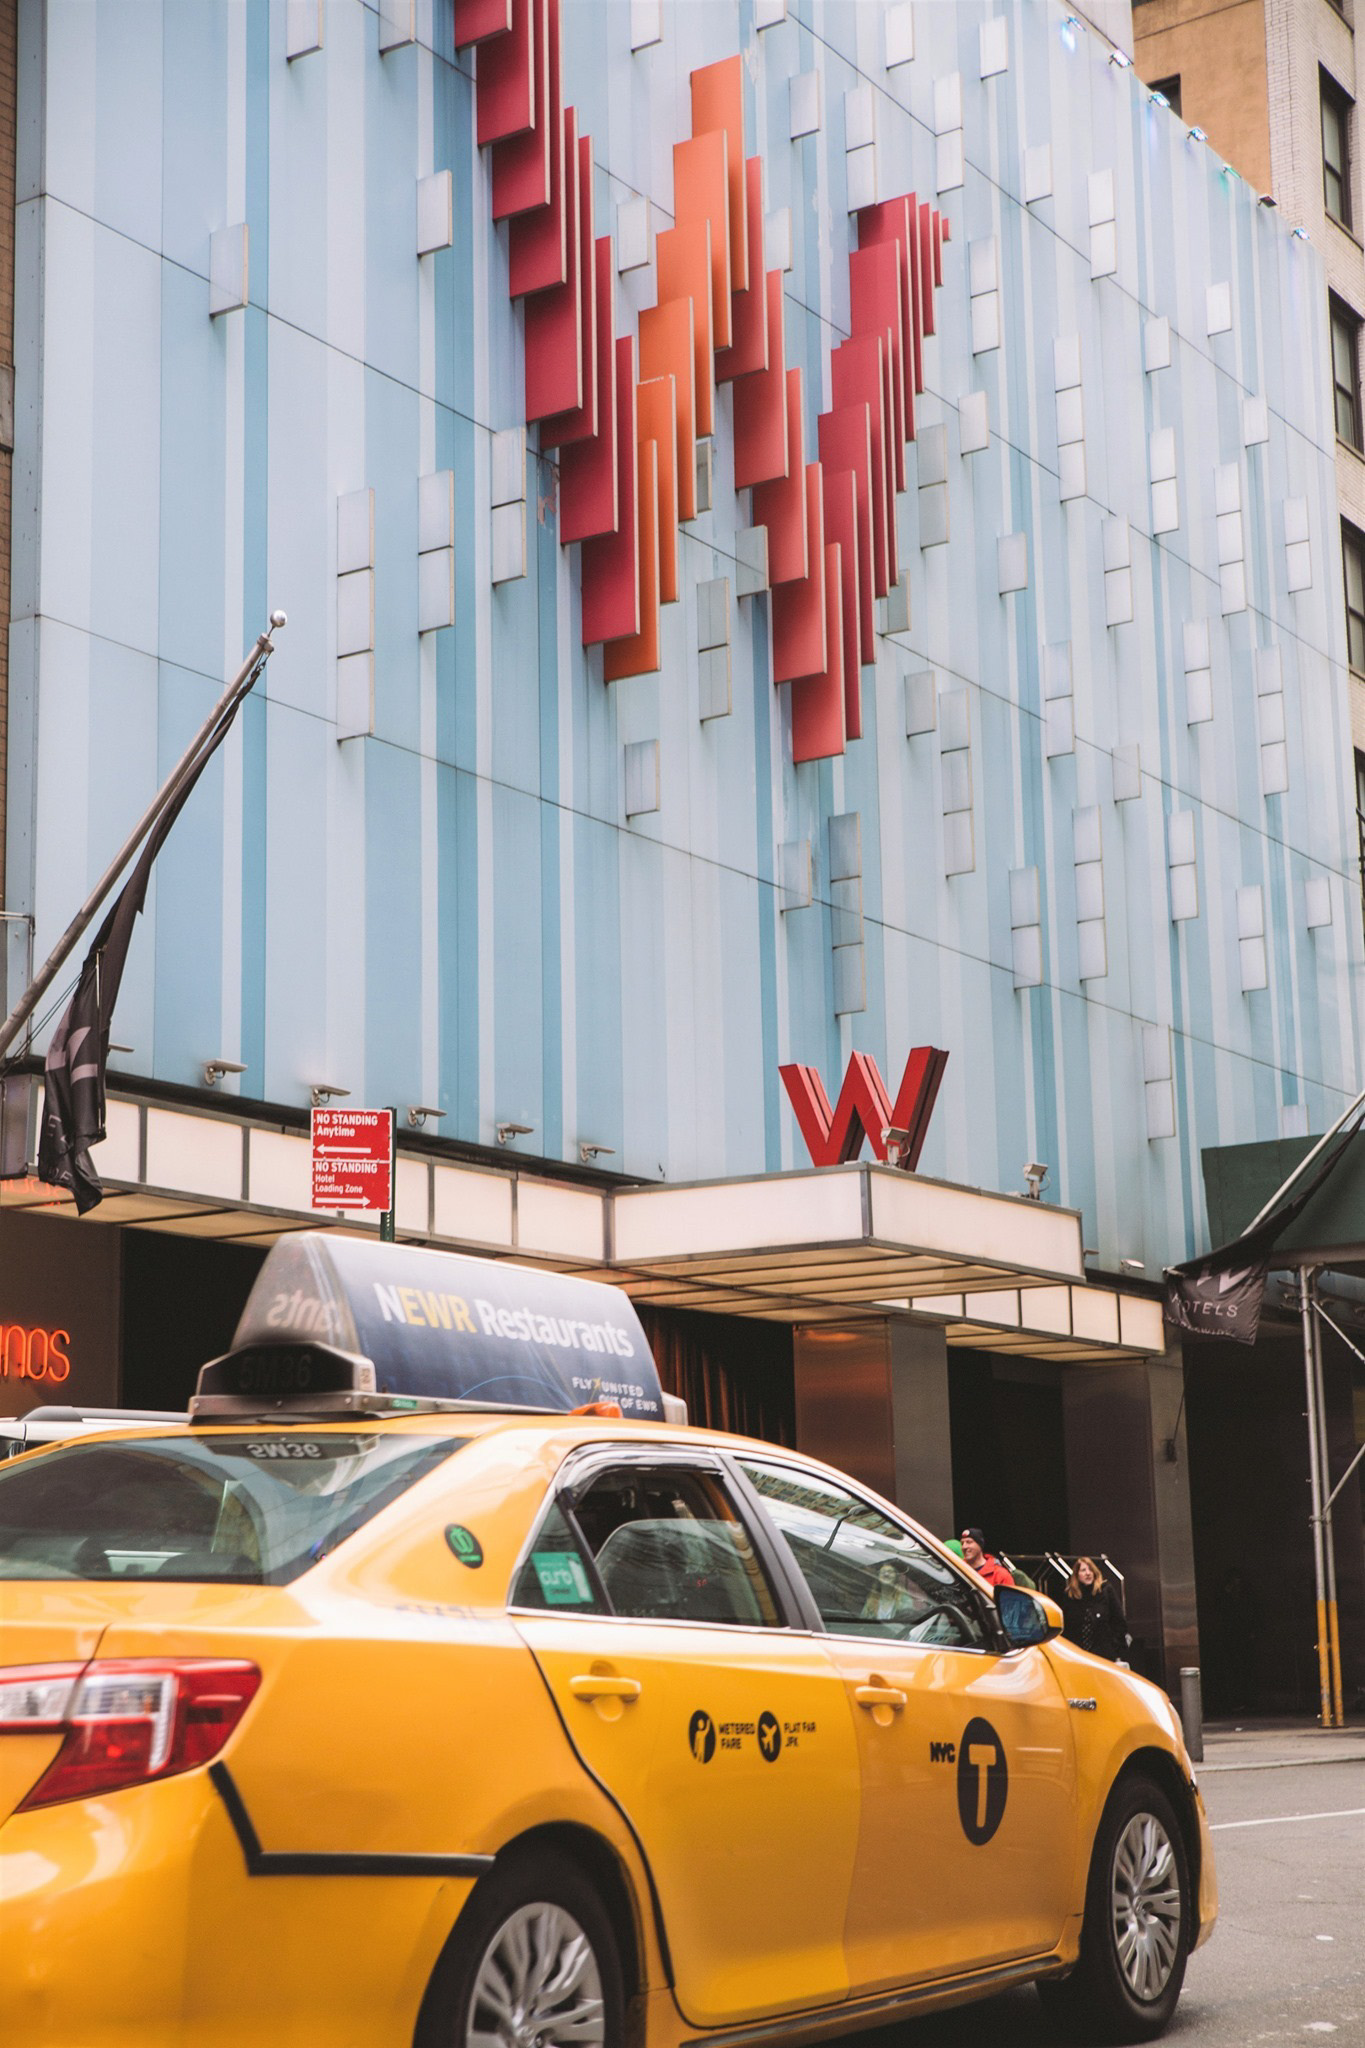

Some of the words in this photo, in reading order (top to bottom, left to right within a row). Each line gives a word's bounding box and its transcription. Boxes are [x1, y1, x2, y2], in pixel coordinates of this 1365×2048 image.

[778, 1046, 950, 1172] W
[316, 1113, 330, 1124] NO
[332, 1114, 379, 1126] STANDING
[316, 1125, 356, 1138] Anytime
[315, 1162, 329, 1173] NO
[331, 1162, 379, 1174] STANDING
[315, 1174, 335, 1183] Hotel
[315, 1184, 344, 1194] Loading
[345, 1184, 363, 1194] Zone
[373, 1282, 477, 1334] NEWR
[475, 1299, 635, 1358] Restaurants
[571, 1376, 592, 1390] FLY
[601, 1381, 644, 1398] UNITED
[620, 1397, 634, 1409] OF
[635, 1399, 658, 1412] EWR
[721, 1738, 742, 1750] FARE
[930, 1741, 956, 1764] NYC
[968, 1743, 997, 1829] T
